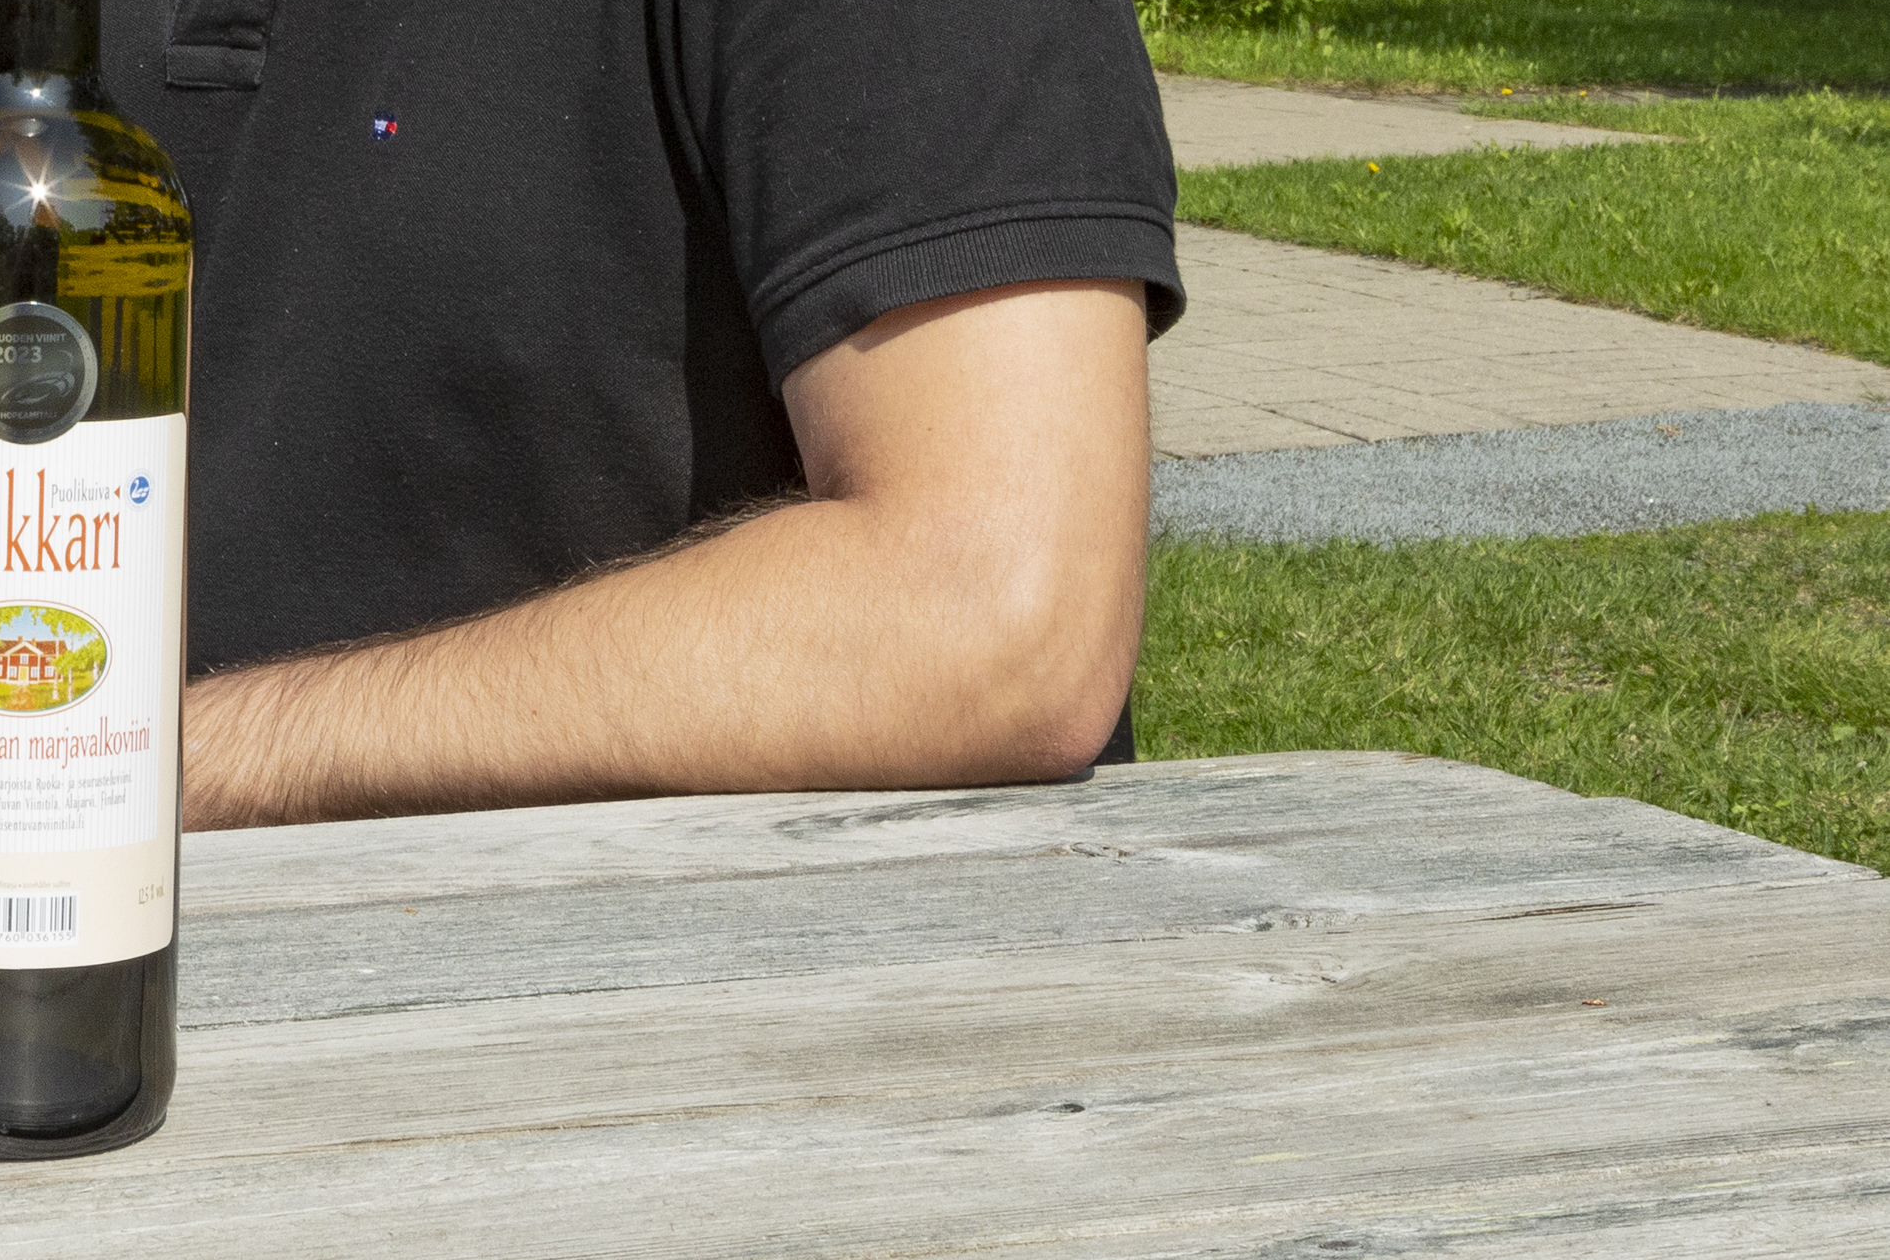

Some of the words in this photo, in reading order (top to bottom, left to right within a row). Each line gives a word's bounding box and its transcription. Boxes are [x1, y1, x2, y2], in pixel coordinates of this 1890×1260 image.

[51, 478, 111, 508] Puolikuiva
[28, 716, 151, 769] marjavalkoviini
[68, 778, 75, 793] ja
[26, 931, 73, 943] 036155
